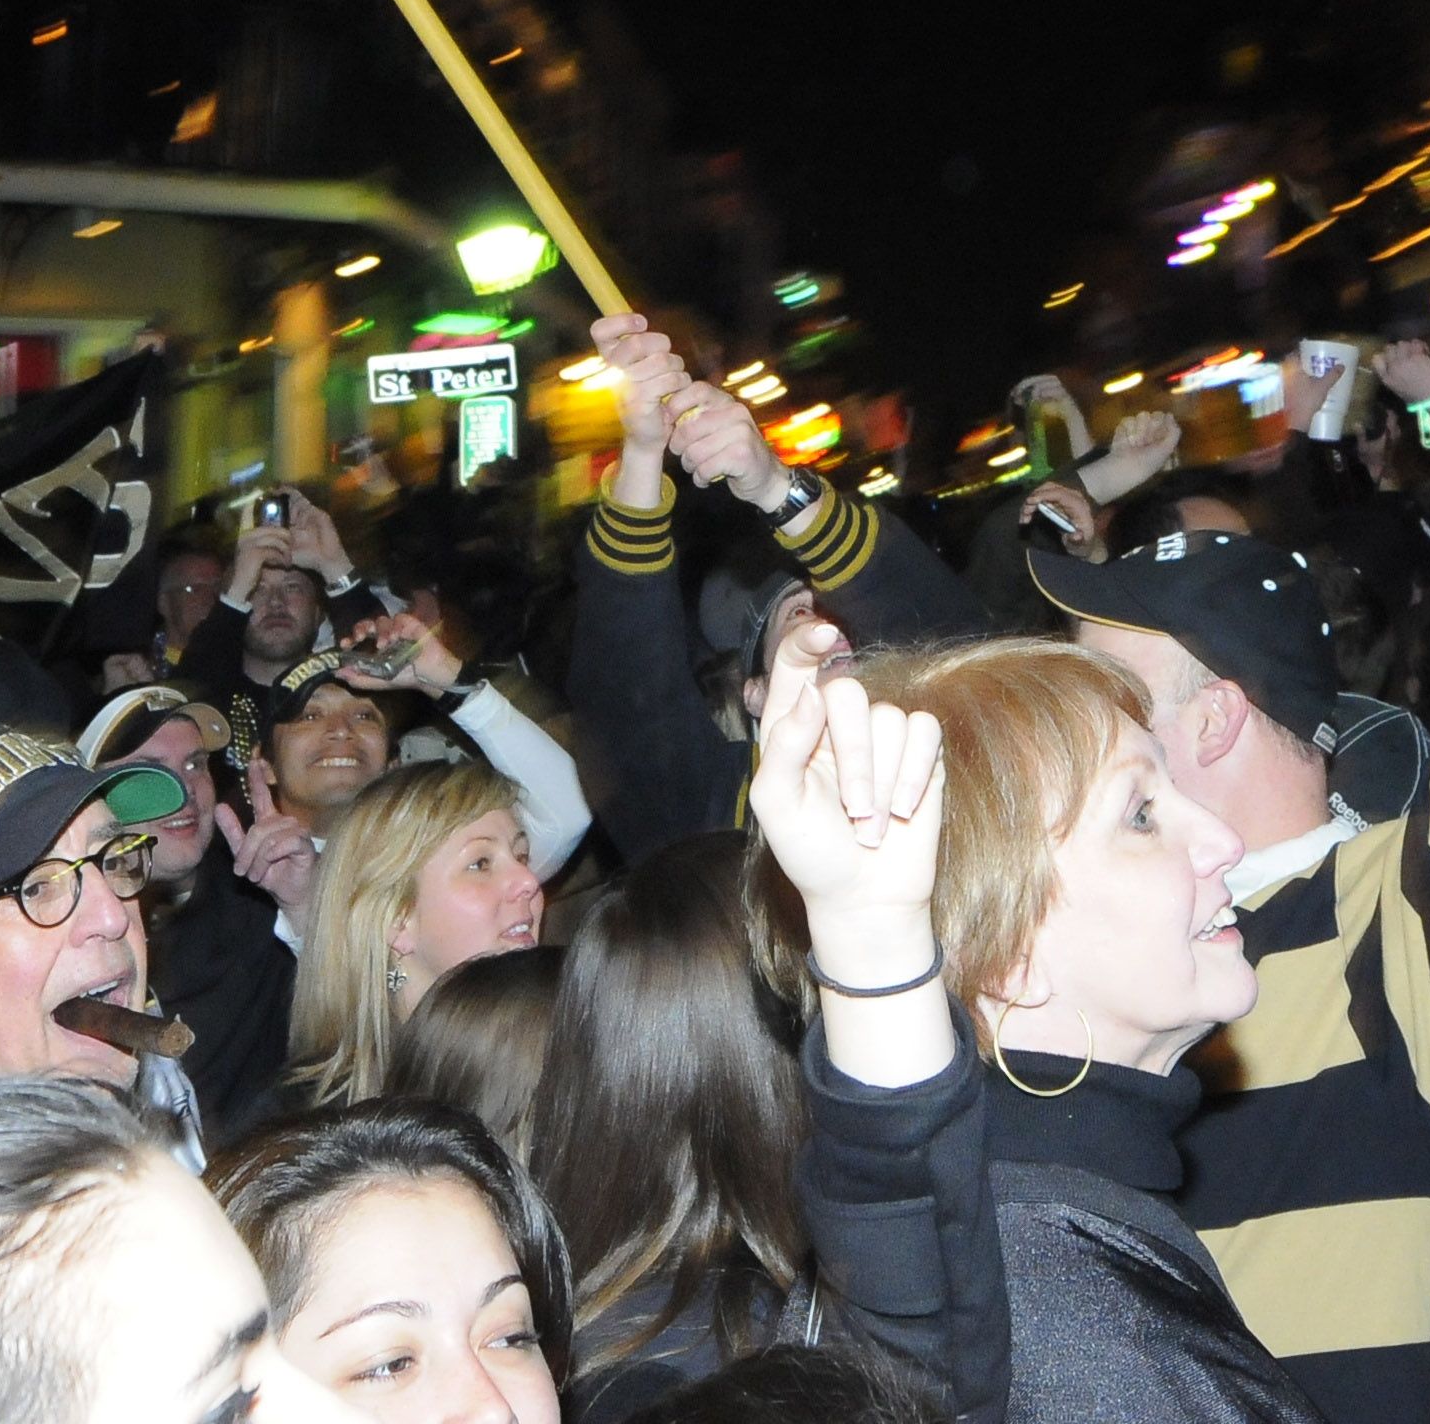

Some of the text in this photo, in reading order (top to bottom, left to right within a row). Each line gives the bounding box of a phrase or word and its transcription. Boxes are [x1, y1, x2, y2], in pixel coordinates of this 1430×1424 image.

[378, 367, 507, 397] St Peter
[1329, 791, 1373, 833] Reebo
